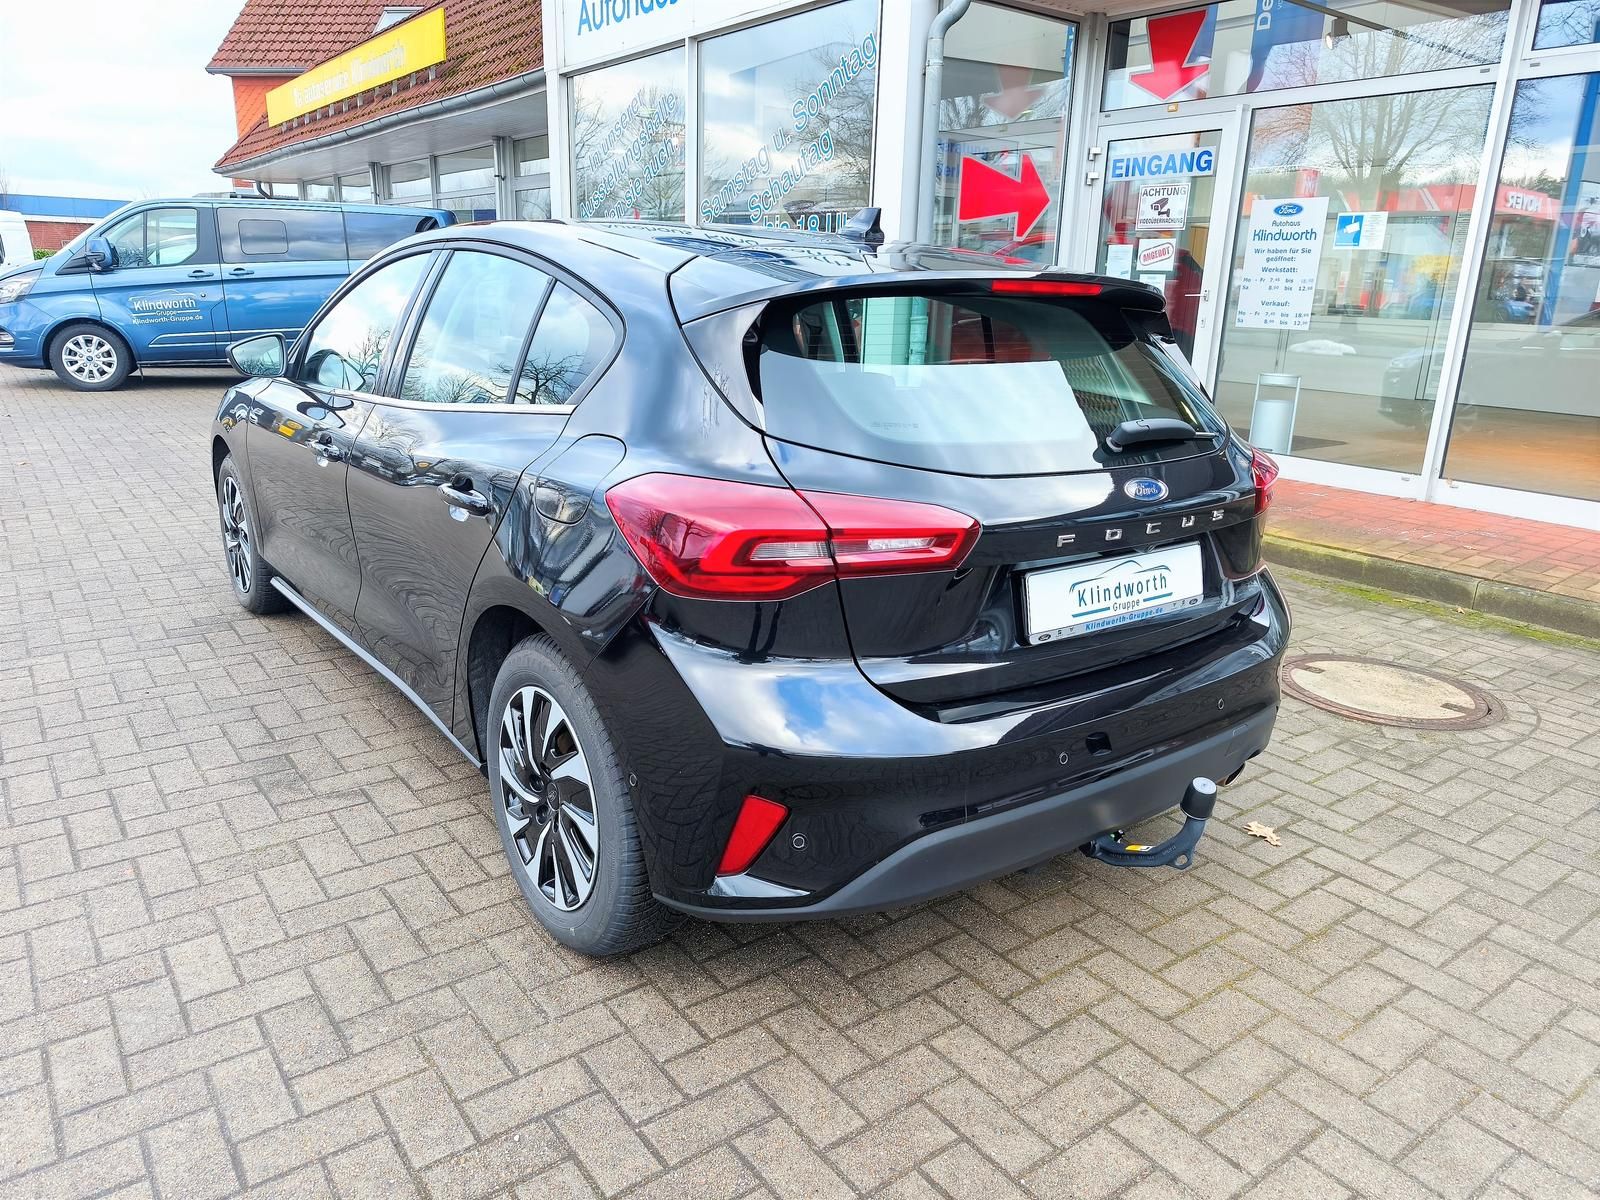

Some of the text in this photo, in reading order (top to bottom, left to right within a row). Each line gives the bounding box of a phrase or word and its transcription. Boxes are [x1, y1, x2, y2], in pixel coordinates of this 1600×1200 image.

[577, 0, 678, 36] Autoha
[700, 143, 771, 223] Samstag
[791, 32, 877, 131] Sonntag
[747, 129, 834, 223] Schautag
[1111, 150, 1213, 178] EINGANG
[1142, 187, 1187, 197] ACHTUNG
[1253, 228, 1317, 241] Klindworth
[1142, 246, 1171, 263] ANGEBOT
[134, 298, 196, 311] Klindworth
[132, 315, 203, 325] Klindworth-Gruppe.de
[1056, 509, 1225, 548] FOCUS
[1078, 573, 1167, 608] Klindworth
[1112, 599, 1140, 612] Gruppe
[1085, 607, 1164, 631] Klindworth-Gruppe.de
